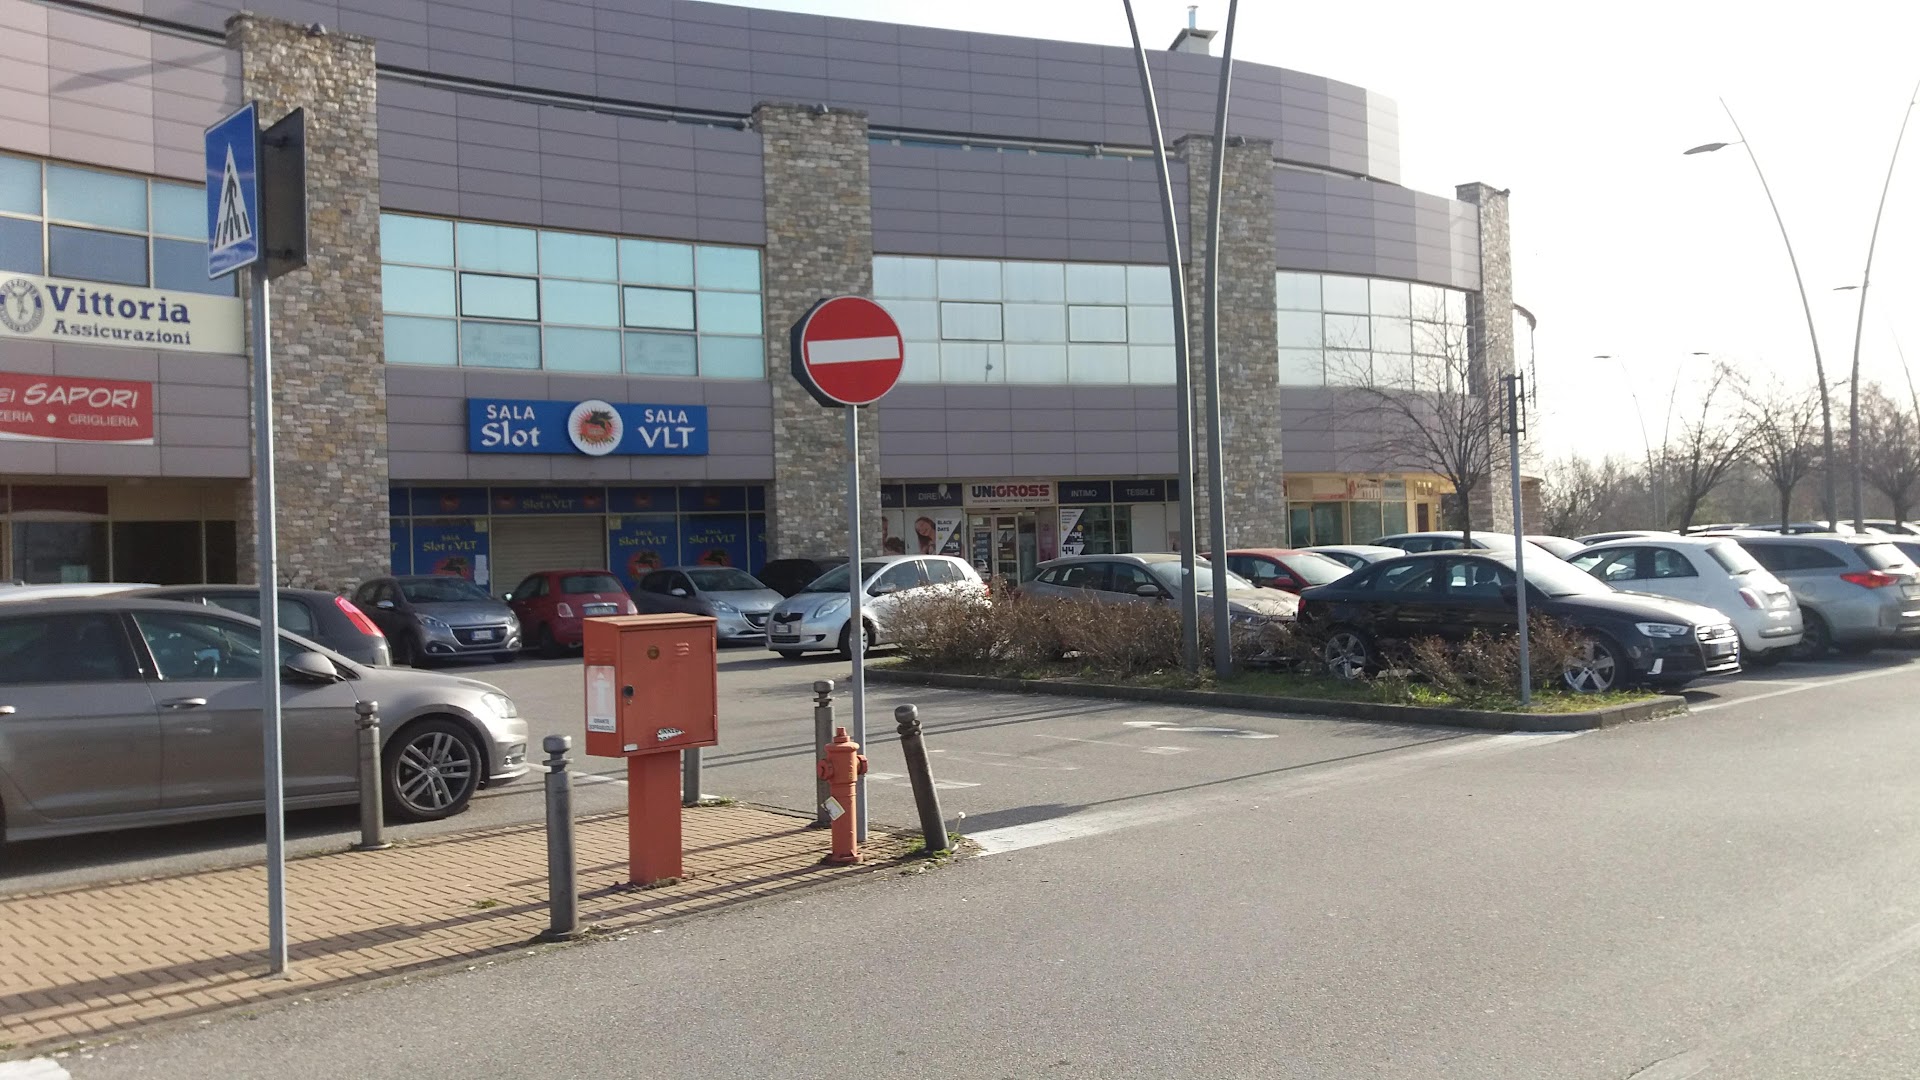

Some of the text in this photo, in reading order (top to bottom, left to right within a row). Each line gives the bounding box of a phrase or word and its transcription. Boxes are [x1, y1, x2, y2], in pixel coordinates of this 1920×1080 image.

[46, 285, 190, 323] Vittoria
[53, 319, 190, 344] Assicurazioni
[24, 383, 138, 408] SAPORI
[68, 413, 138, 427] GRIGLIERIA
[487, 405, 535, 420] SALA
[645, 409, 688, 423] SALA
[481, 421, 541, 447] Slot
[638, 426, 696, 449] VLT
[423, 541, 444, 551] Slot
[454, 541, 477, 550] VLT
[618, 536, 639, 545] Slot
[647, 536, 667, 544] VLT
[688, 535, 708, 543] Slot
[716, 534, 736, 543] VLT
